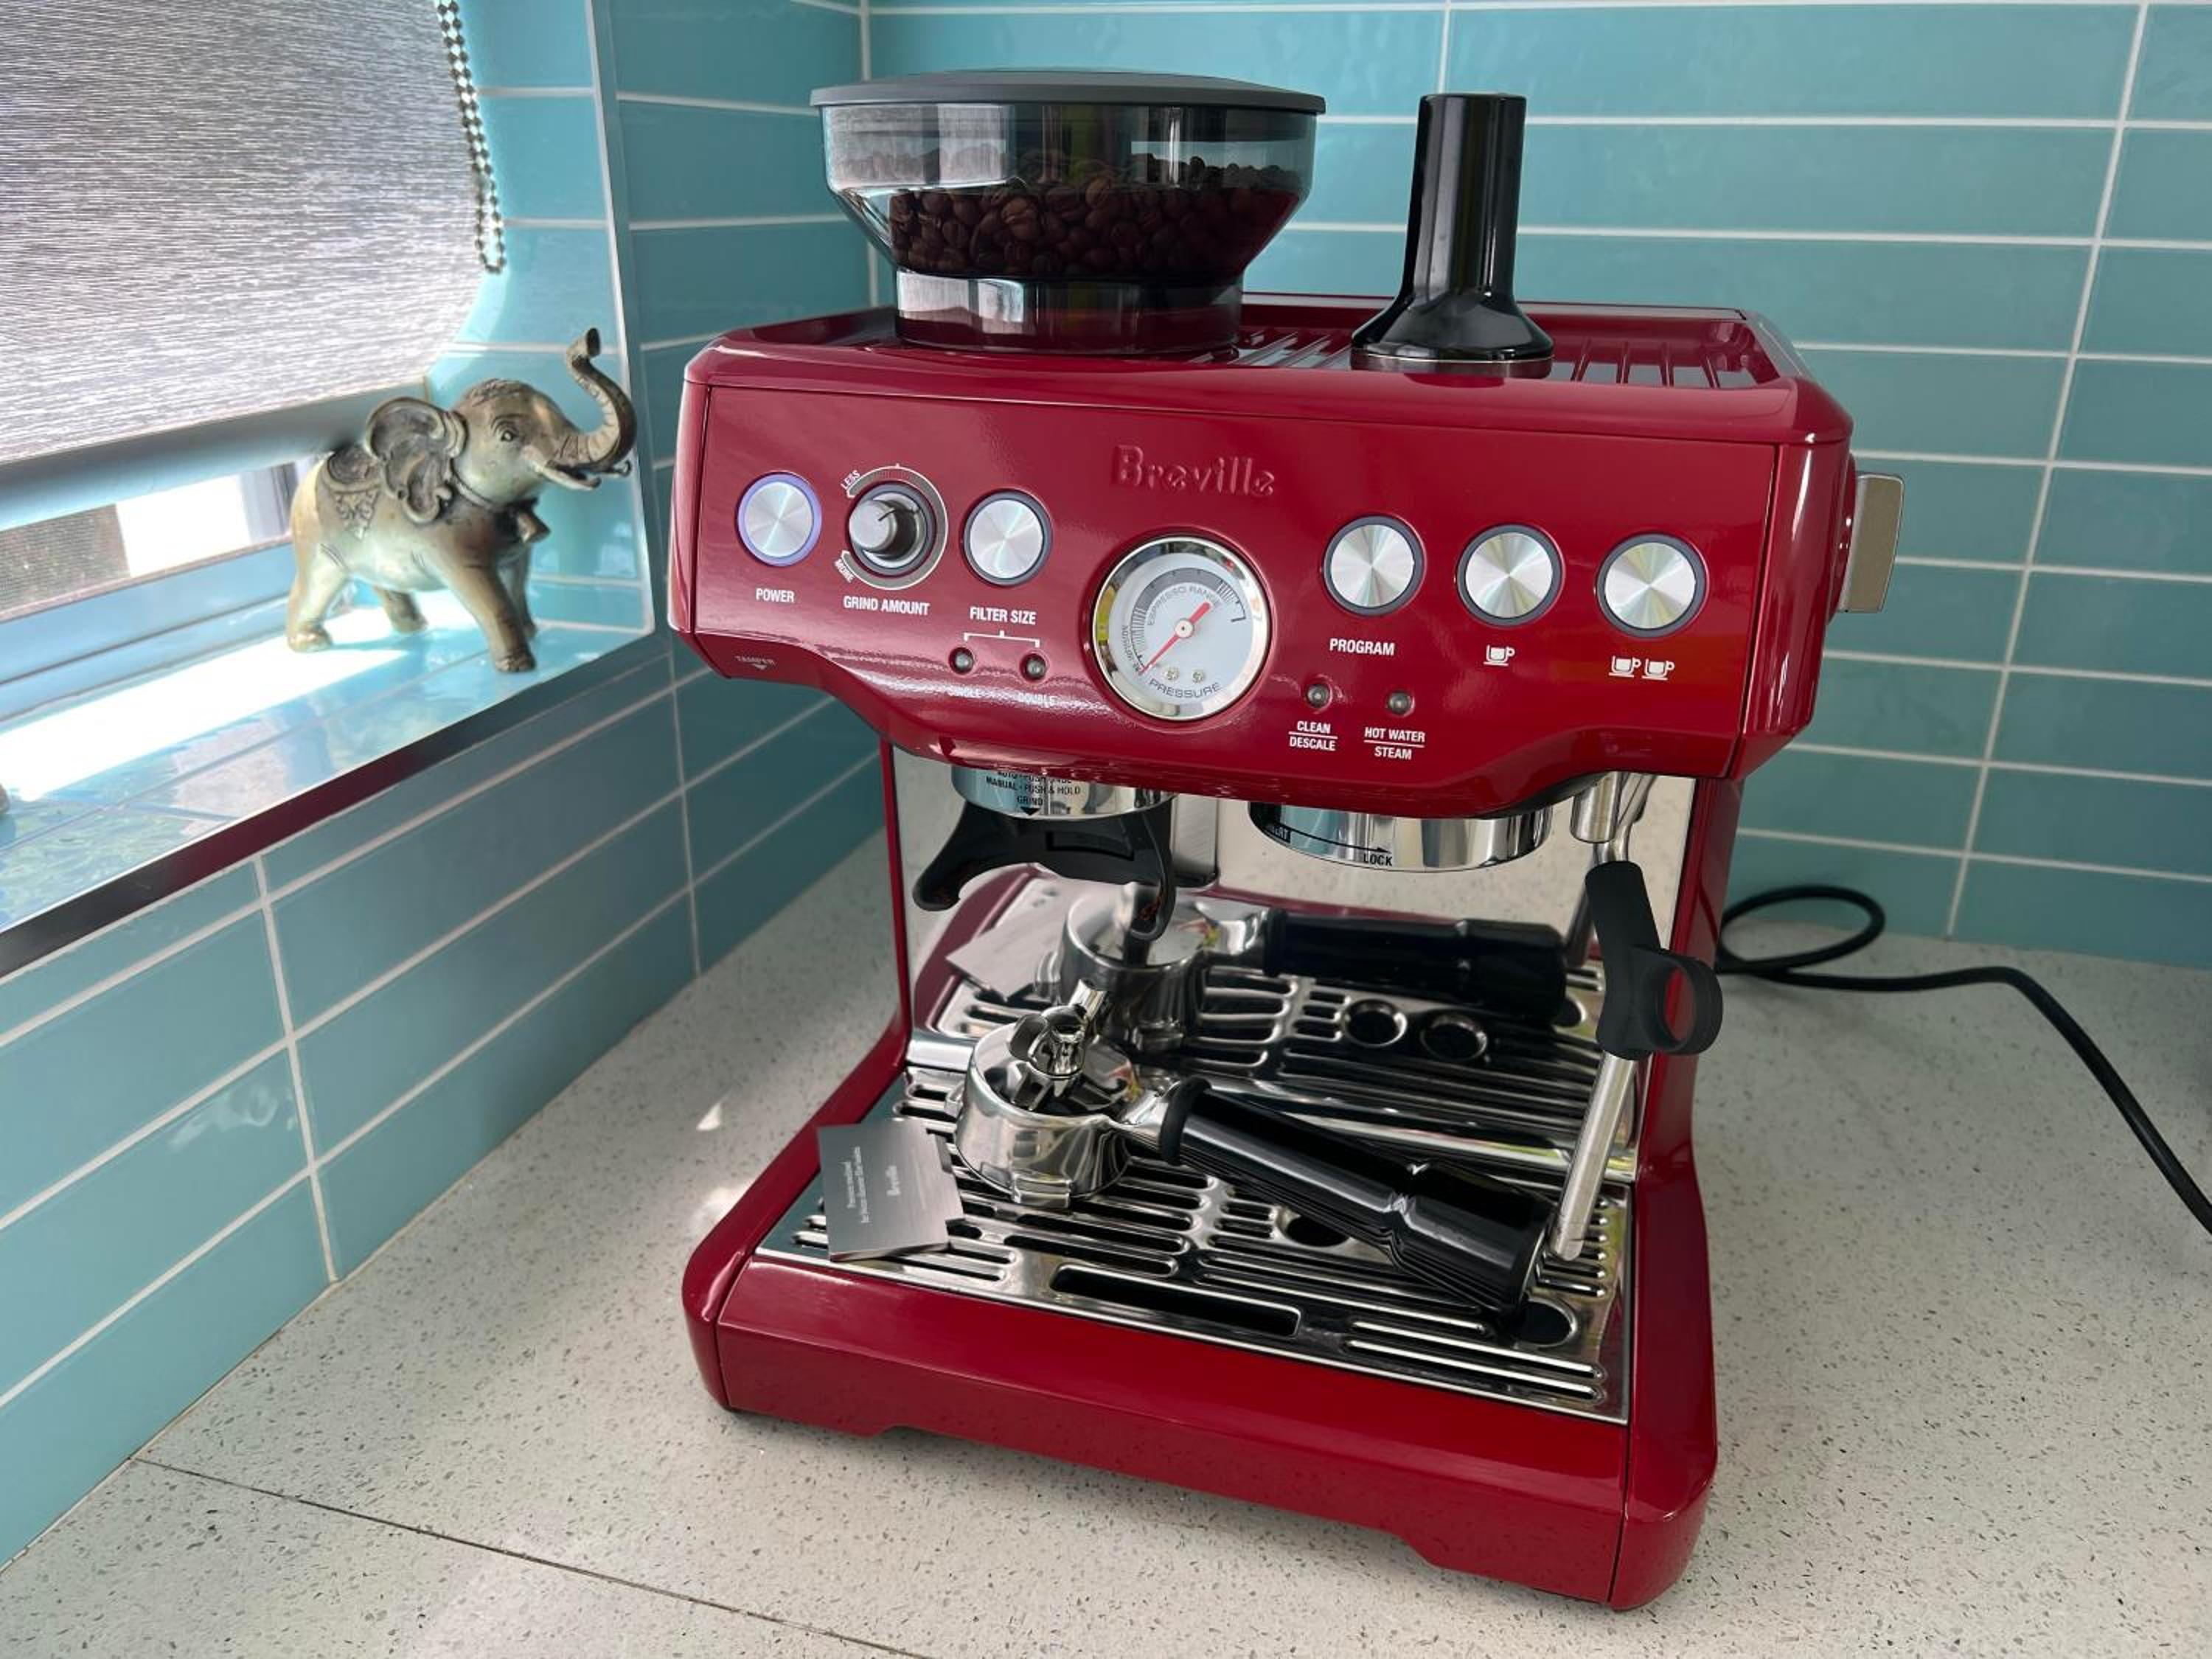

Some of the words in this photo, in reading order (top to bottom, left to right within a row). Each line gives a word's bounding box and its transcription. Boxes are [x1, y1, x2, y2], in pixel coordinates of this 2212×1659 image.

[1110, 444, 1276, 495] Breville
[834, 558, 855, 582] MORE
[756, 588, 795, 603] POWER
[843, 595, 878, 611] GRIND
[880, 599, 931, 616] AMOUNT
[970, 606, 1008, 623] FILTER
[1010, 610, 1036, 625] SIZE
[1329, 638, 1395, 656] PROGRAM
[1149, 678, 1221, 698] PRESSURE
[1297, 720, 1331, 734] CLEAN
[1365, 727, 1386, 739] HOT
[1389, 728, 1425, 742] WATER
[1290, 736, 1336, 751] DESCALE
[1374, 746, 1412, 760] STEAM
[986, 776, 1018, 791] MANUAL
[1026, 783, 1047, 795] PUSH
[1057, 785, 1081, 796] HOLD
[1017, 796, 1043, 807] GRIND
[1363, 852, 1393, 866] LOCK
